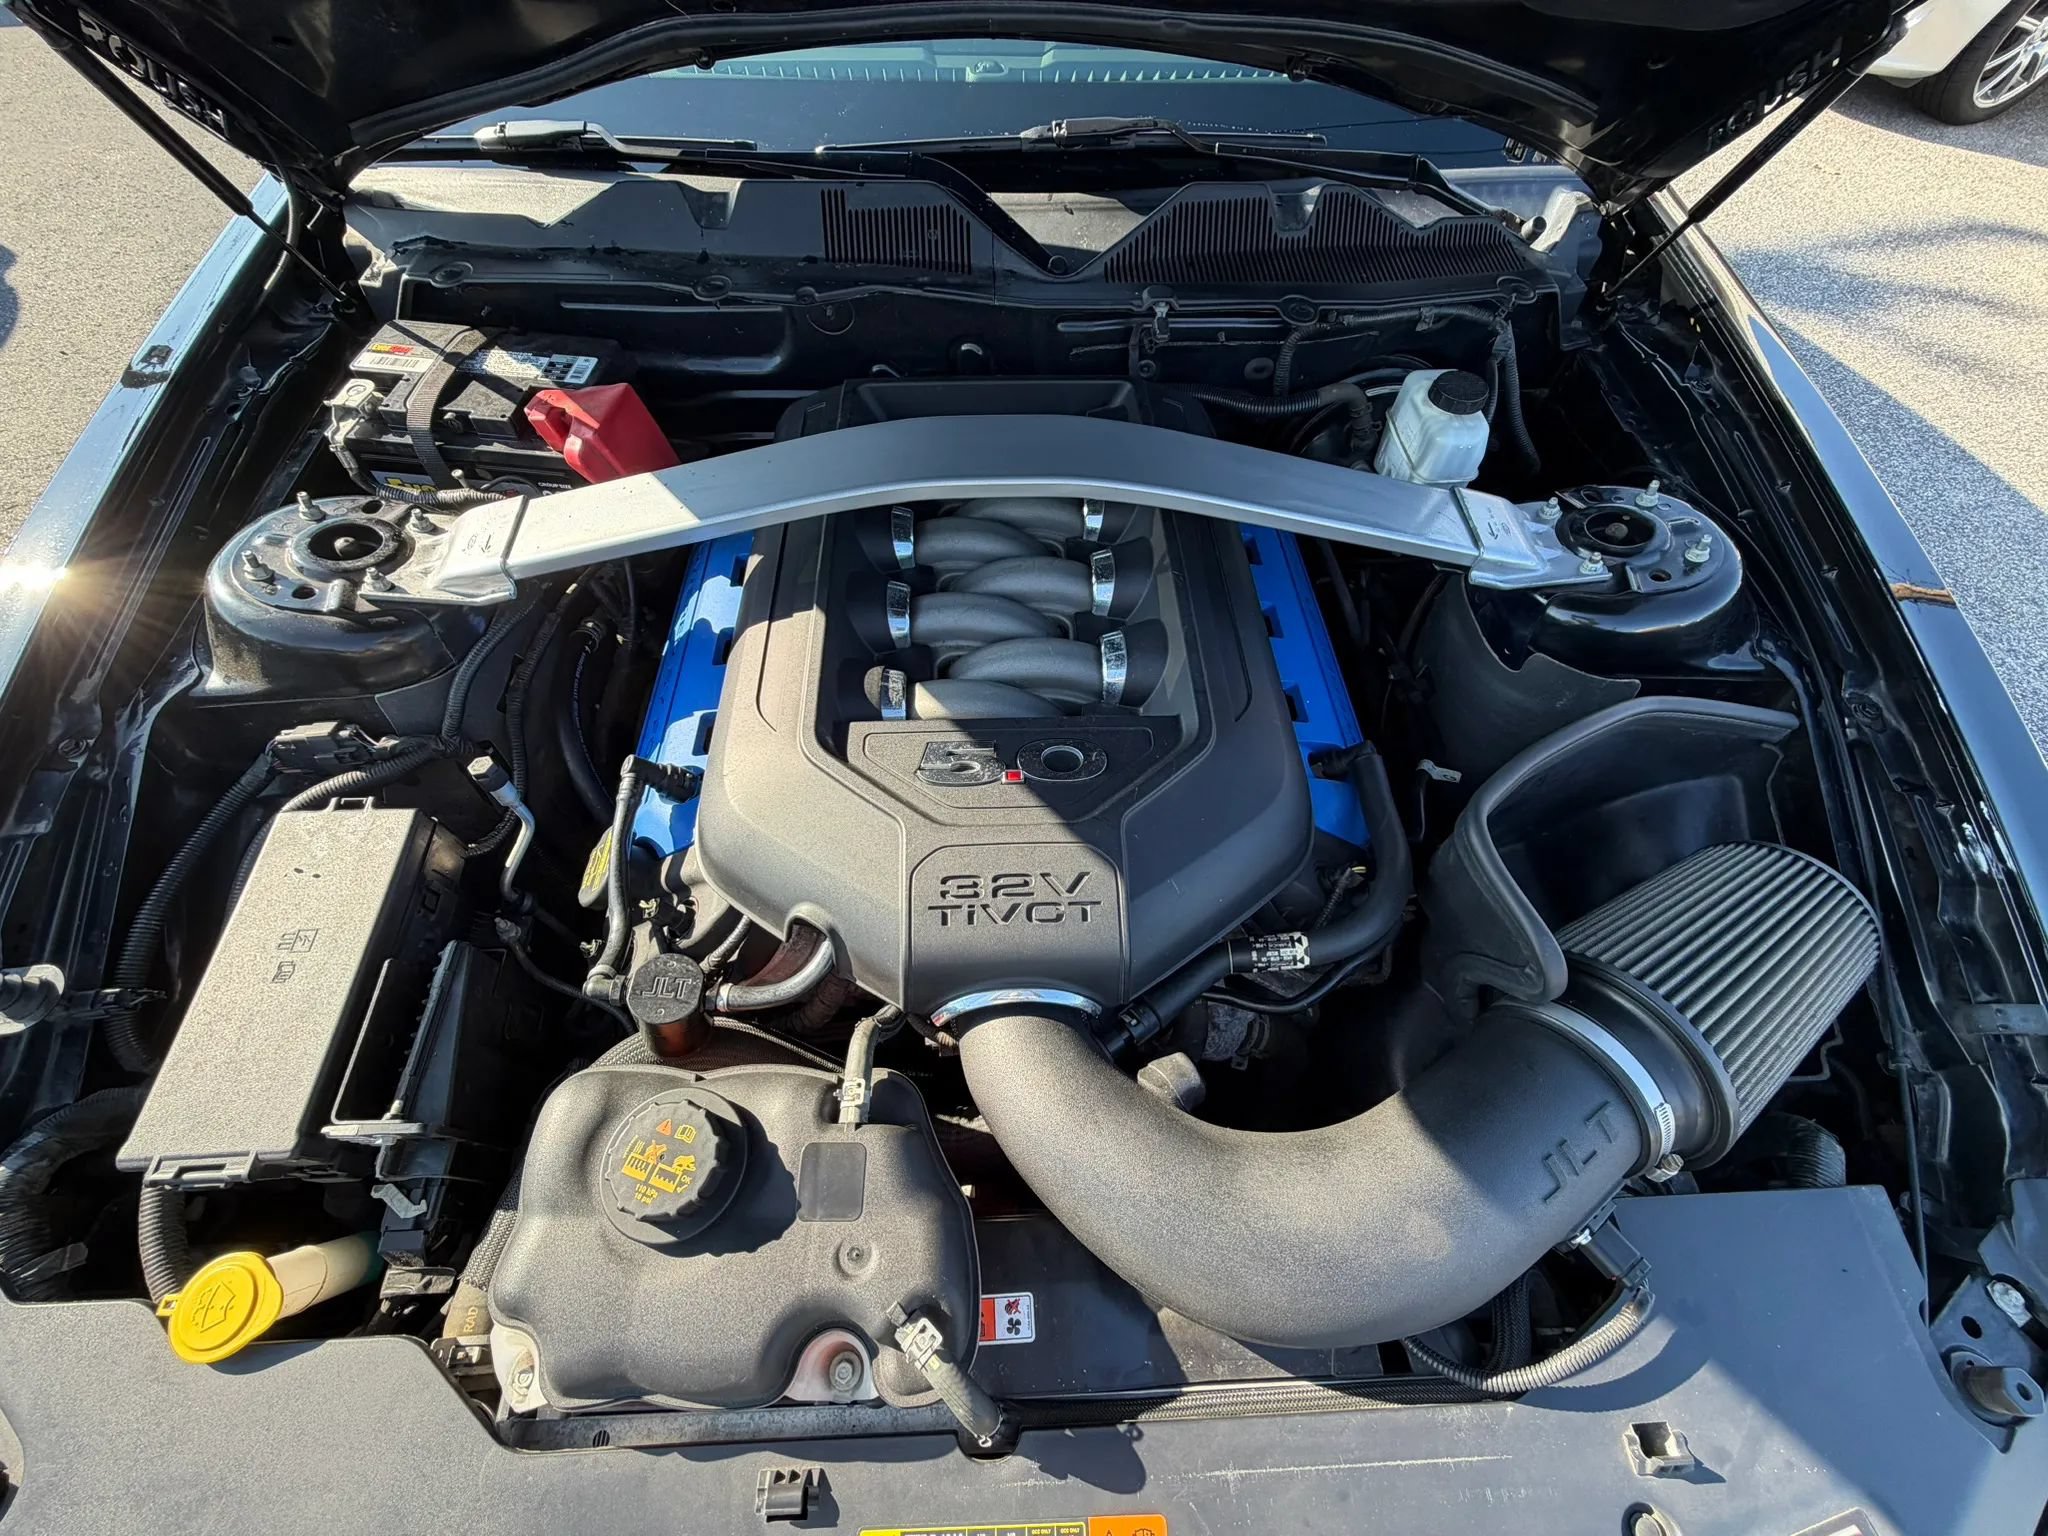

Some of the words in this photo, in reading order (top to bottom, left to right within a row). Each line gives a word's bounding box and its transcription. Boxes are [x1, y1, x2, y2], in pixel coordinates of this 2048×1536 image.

[915, 739, 1108, 786] 5.0
[940, 871, 1092, 900] 32V
[640, 976, 693, 998] JLT
[1542, 1100, 1619, 1205] JLT
[681, 1175, 693, 1184] OK
[462, 1306, 479, 1334] RAD
